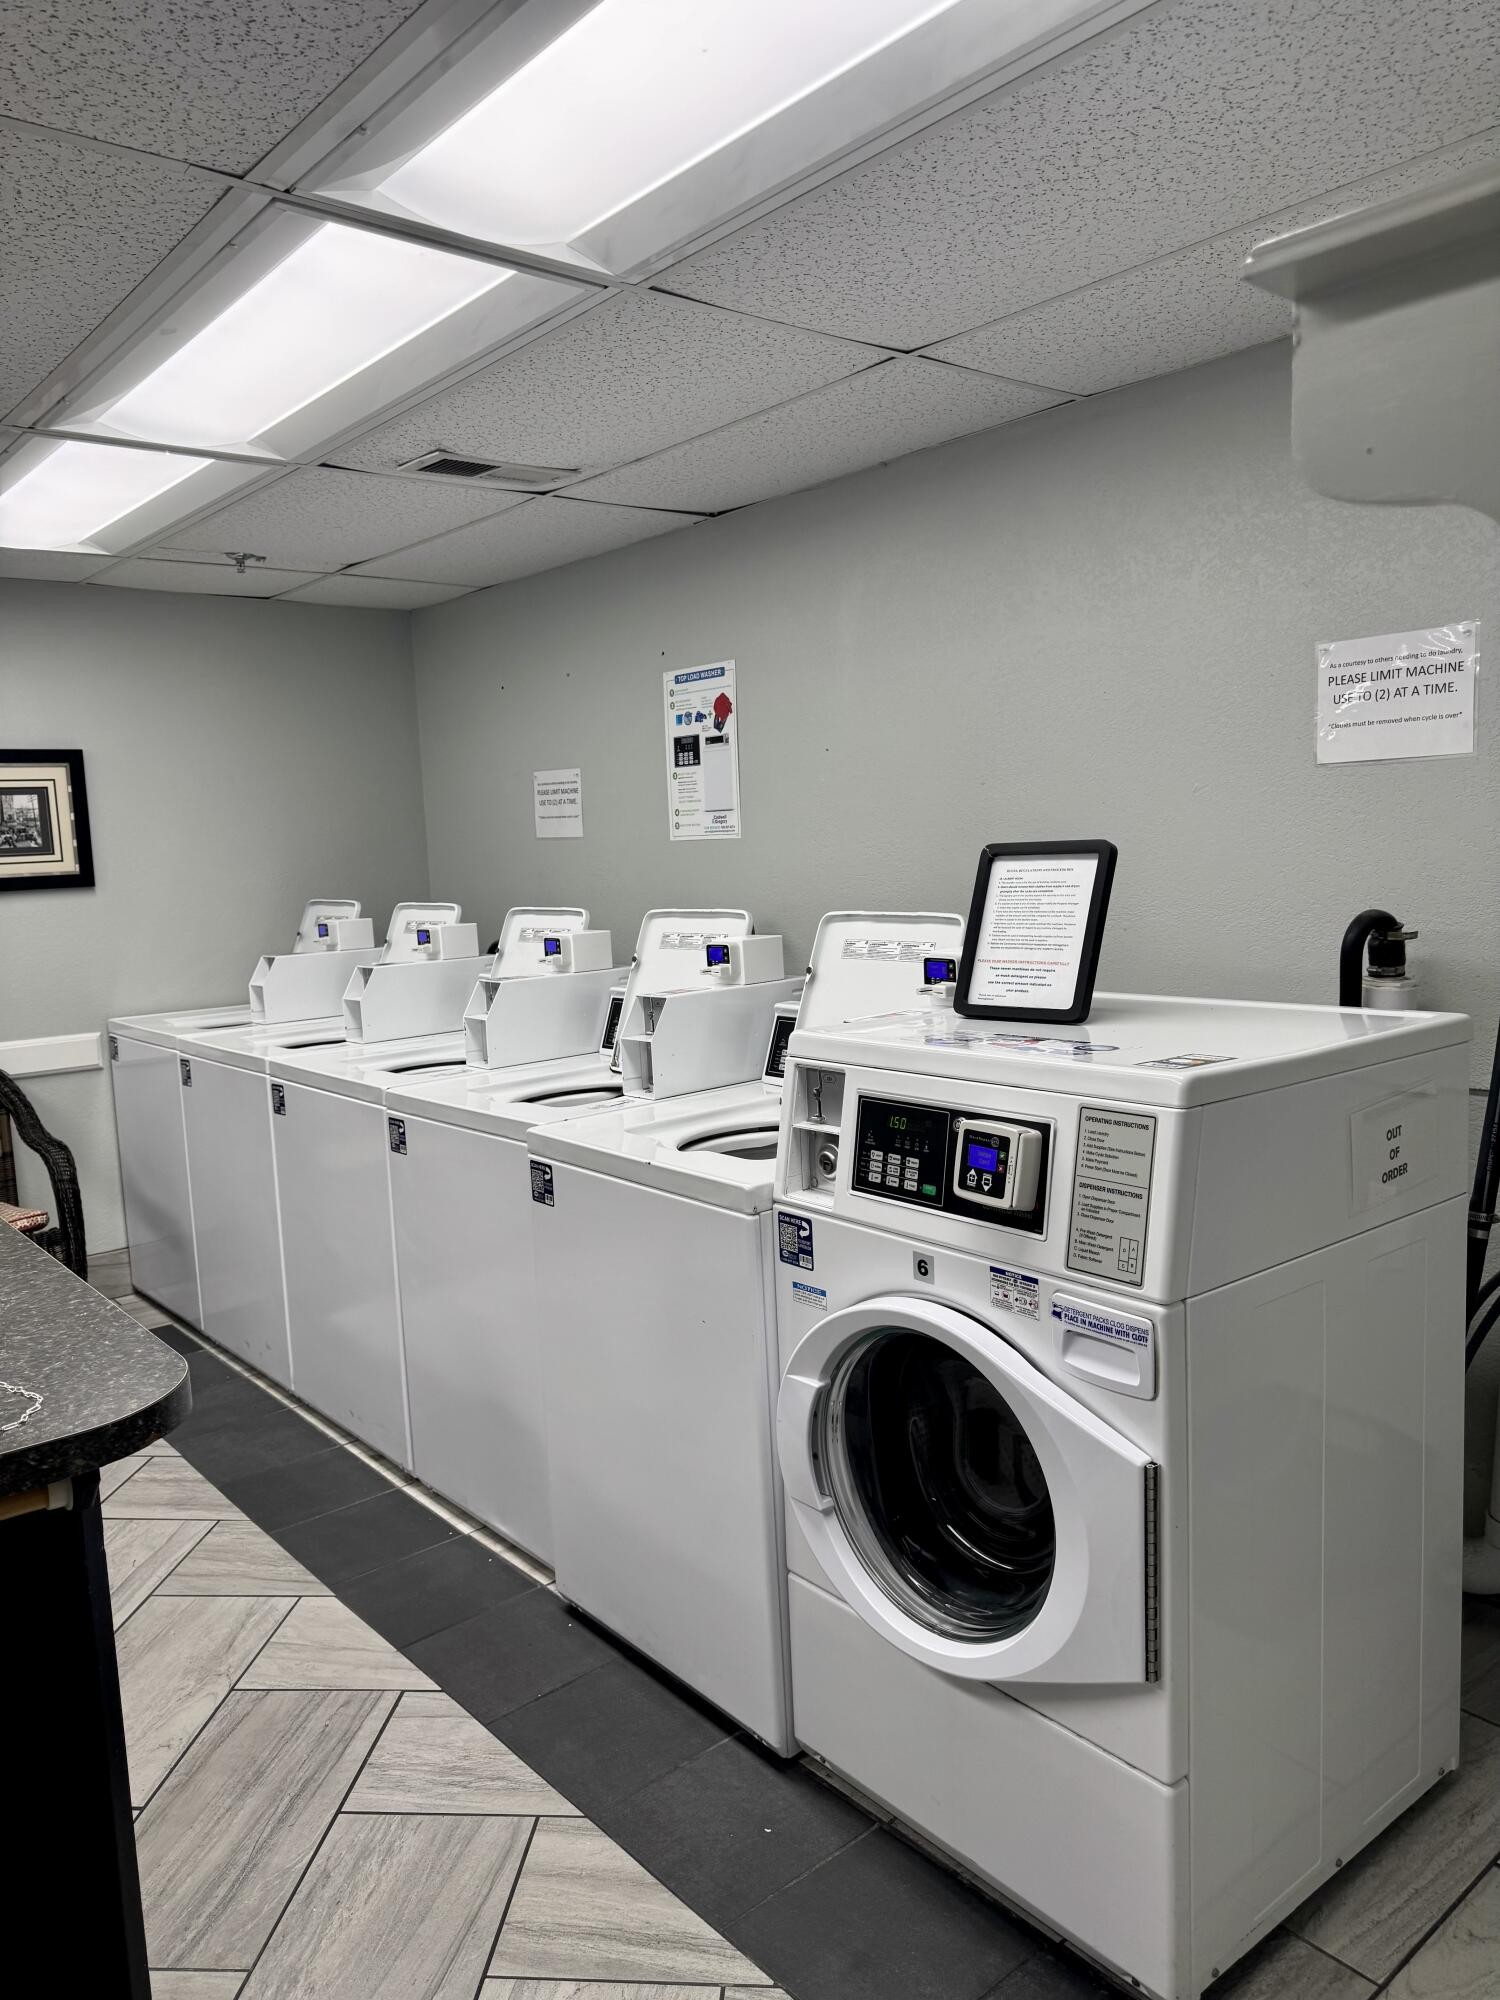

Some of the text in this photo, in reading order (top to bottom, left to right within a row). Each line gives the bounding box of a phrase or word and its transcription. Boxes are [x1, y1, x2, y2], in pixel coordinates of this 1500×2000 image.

[1343, 660, 1366, 668] courtesy
[701, 669, 722, 678] WASHER
[1328, 661, 1464, 687] PLEASE LIMIT MACHINE
[1333, 682, 1458, 705] USE TO (2) AT A TIME.
[1376, 717, 1403, 725] removed
[1422, 714, 1438, 722] cycle
[1085, 1115, 1150, 1131] OPERATING INSTRUCTIONS
[1386, 1125, 1402, 1141] OUT
[1389, 1146, 1400, 1160] OF
[1382, 1162, 1408, 1184] ORDER
[1079, 1182, 1143, 1200] DISPENSER INSTRUCTIONS
[791, 1218, 802, 1226] HERE
[917, 1259, 929, 1276] 6
[797, 1284, 822, 1295] NOTICE
[1063, 1306, 1092, 1320] DETERGENT
[1093, 1315, 1110, 1326] PACKS
[1110, 1321, 1125, 1330] CLOG
[1064, 1313, 1079, 1324] PLACE
[1088, 1320, 1114, 1334] MACHINE
[1115, 1328, 1130, 1338] WITH
